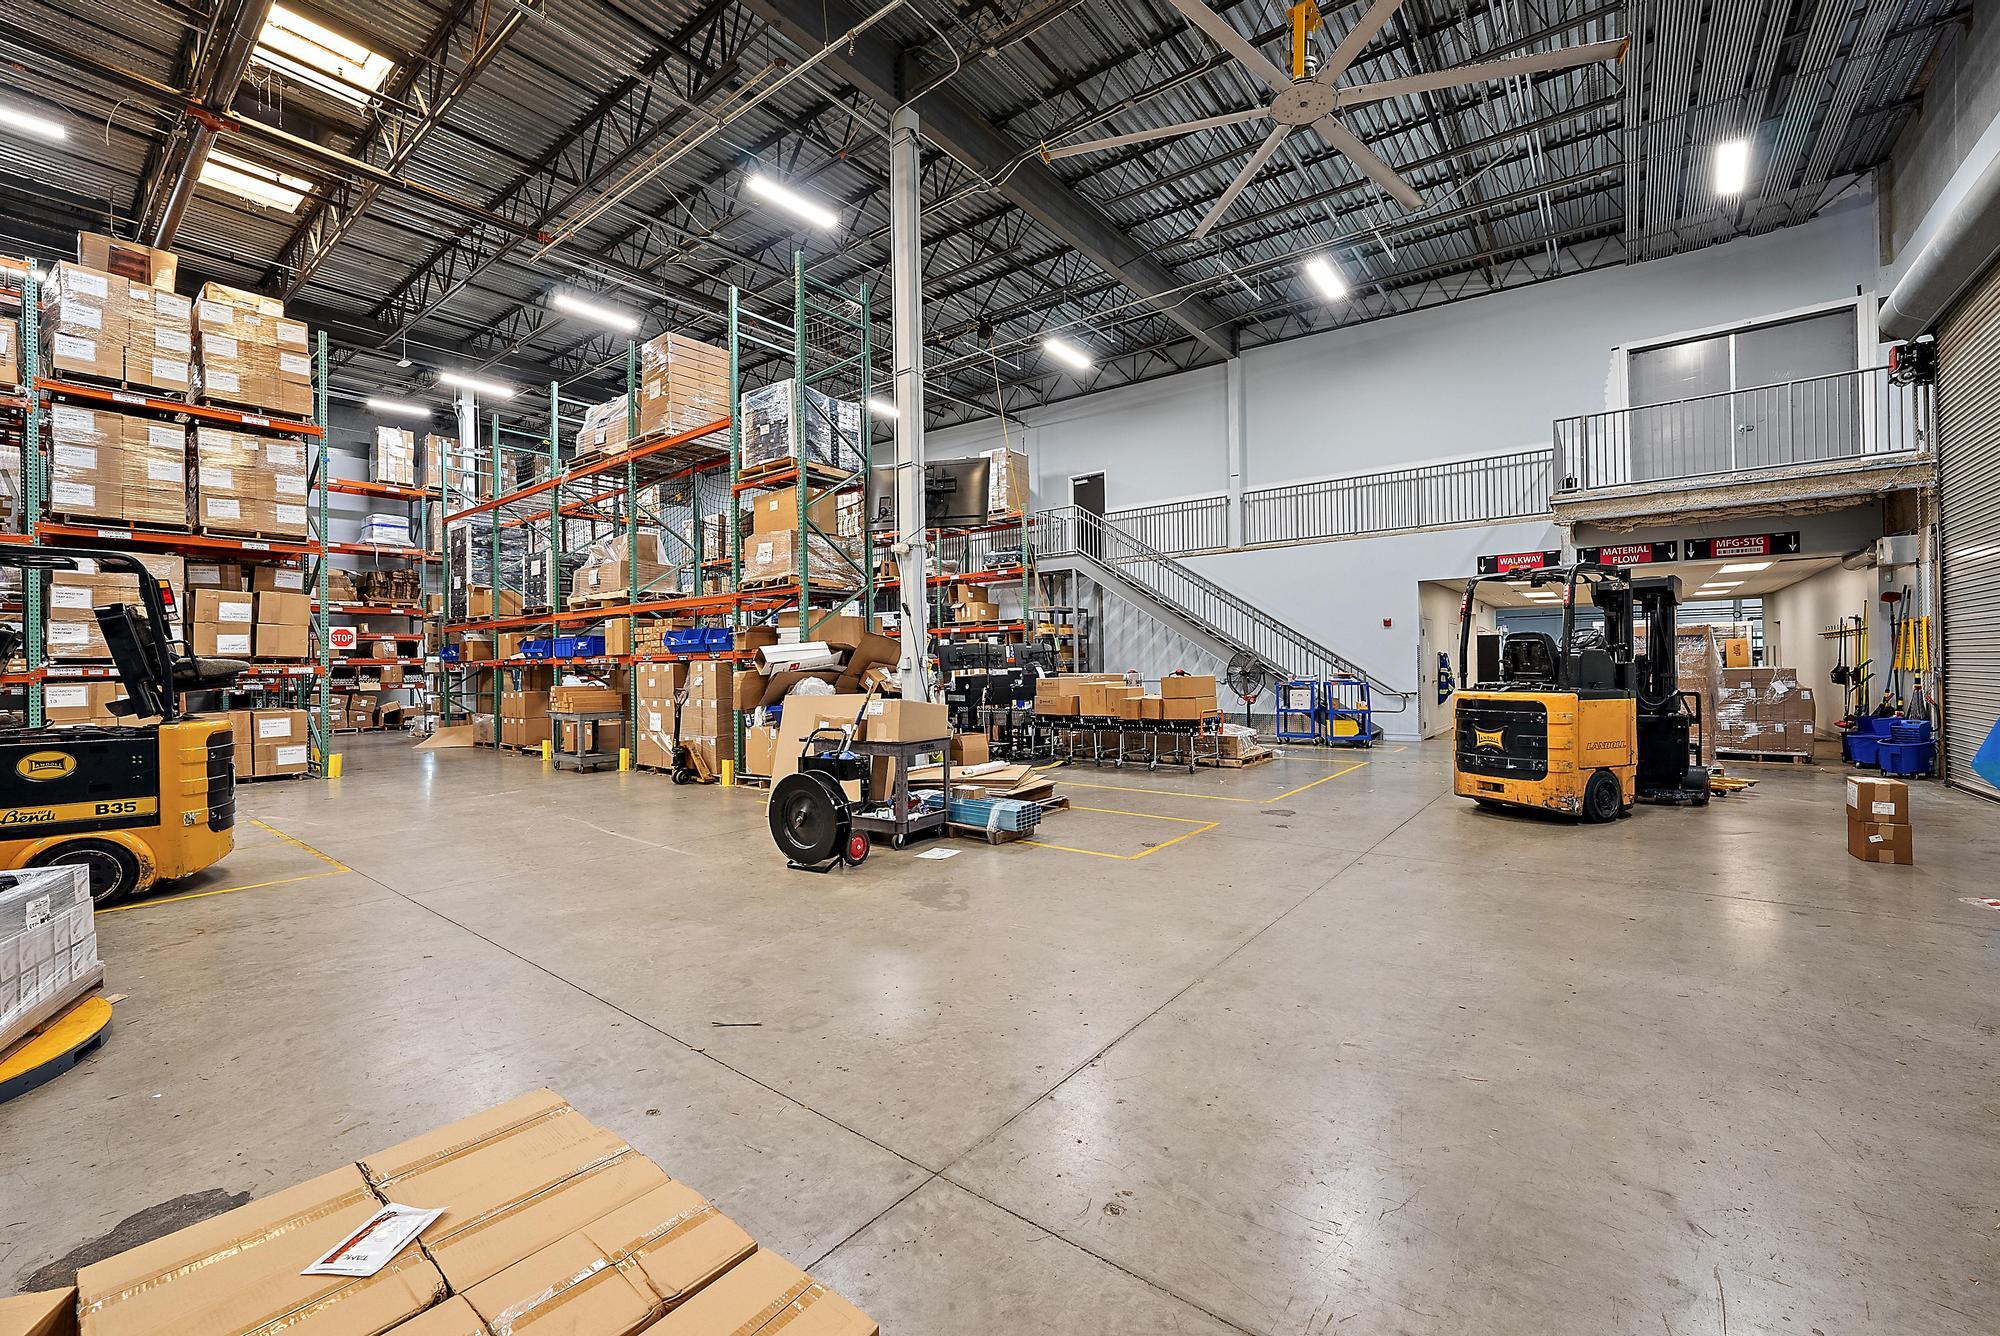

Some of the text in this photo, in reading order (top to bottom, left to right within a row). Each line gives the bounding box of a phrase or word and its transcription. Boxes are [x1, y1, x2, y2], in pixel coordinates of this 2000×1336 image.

[1716, 537, 1764, 548] MFG-STG
[1602, 545, 1650, 556] MATERIAL
[1500, 555, 1542, 565] WALKWAY
[1612, 555, 1640, 564] FLOW
[332, 634, 353, 642] STOP
[1586, 740, 1627, 750] LANDOLL
[96, 801, 137, 815] B35
[0, 809, 56, 824] Bendi
